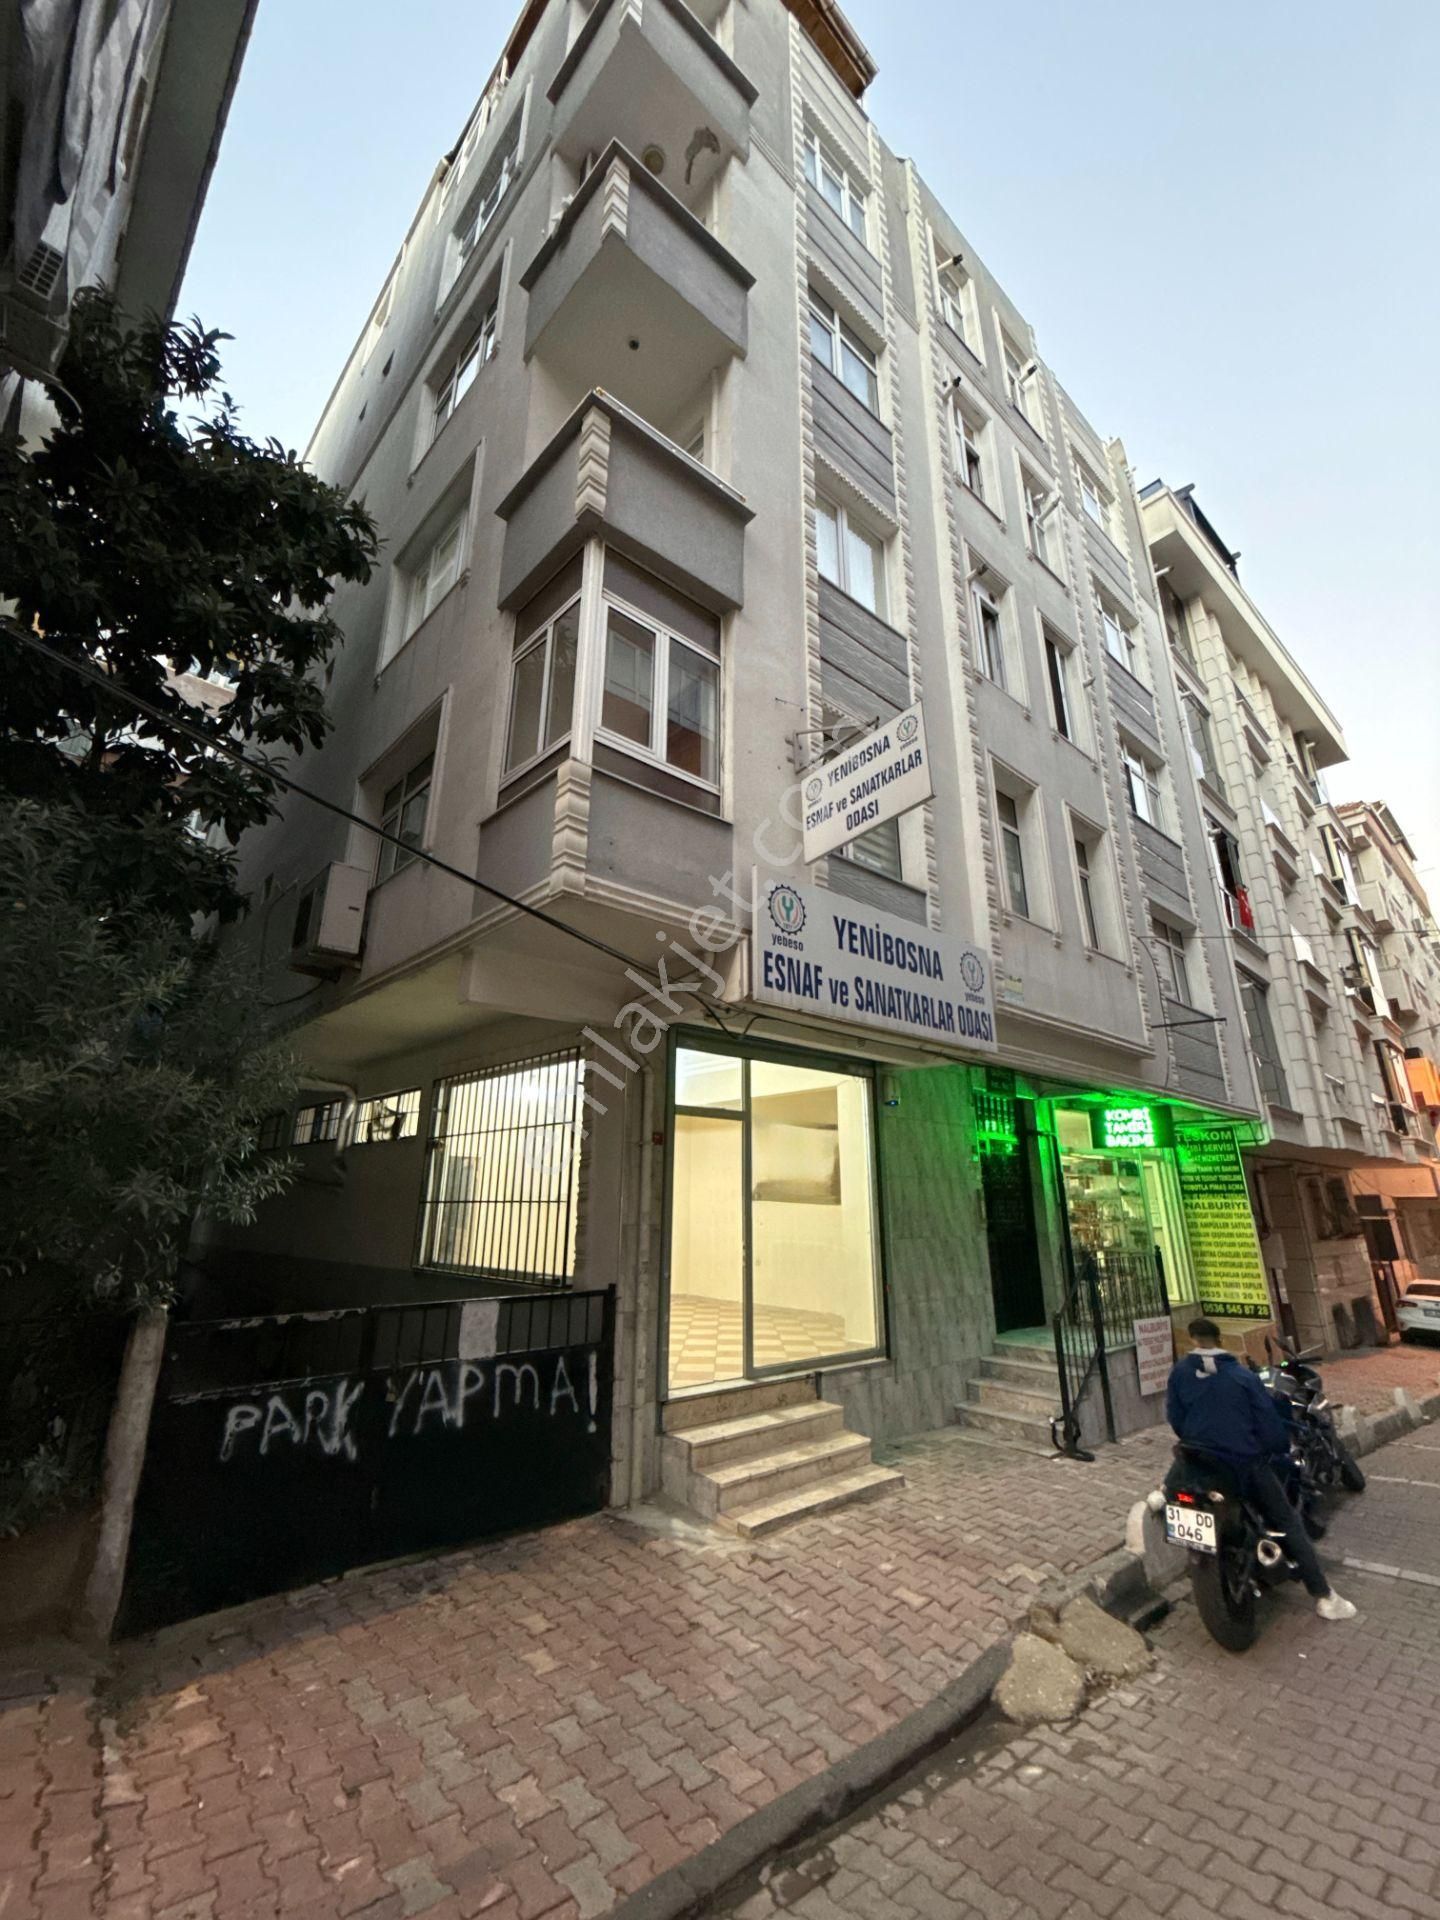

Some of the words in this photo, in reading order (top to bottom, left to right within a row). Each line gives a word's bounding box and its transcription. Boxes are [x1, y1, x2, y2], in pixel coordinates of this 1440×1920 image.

[827, 735, 891, 787] YENİBOSNA
[806, 801, 834, 831] ESNAF
[836, 797, 848, 813] ve
[850, 749, 922, 805] SANATKARLAR
[846, 799, 879, 831] ODASI
[771, 933, 804, 952] yebeso
[833, 915, 944, 981] YENİBOSNA
[763, 950, 823, 1000] ESNAF
[828, 976, 849, 1007] ve
[854, 975, 956, 1035] SANATKARLAR
[958, 1005, 993, 1042] ODASI
[219, 1379, 365, 1463] PARK
[1168, 1507, 1180, 1522] 31
[1196, 1513, 1213, 1528] DD
[1177, 1524, 1203, 1541] 046
